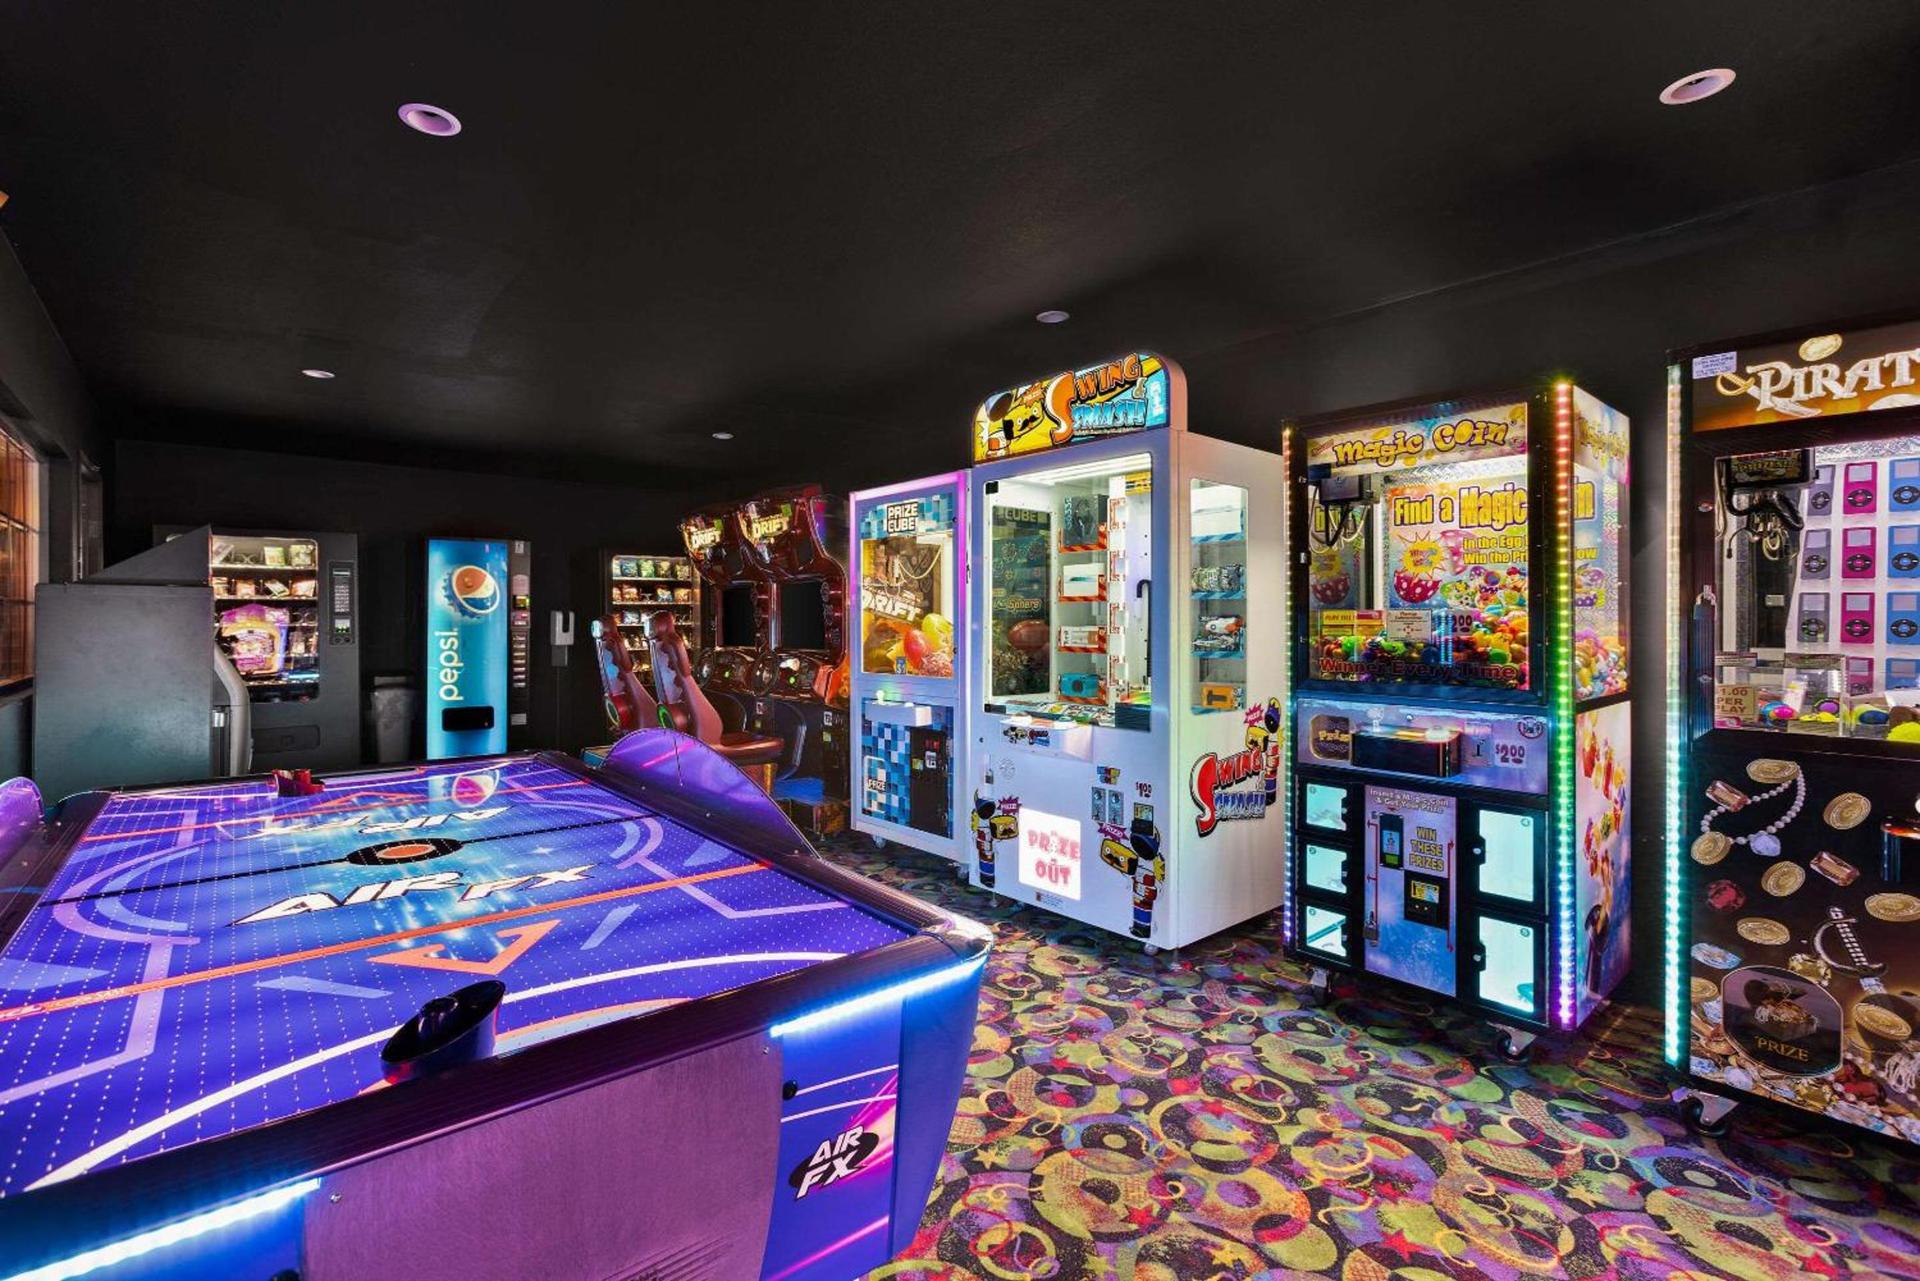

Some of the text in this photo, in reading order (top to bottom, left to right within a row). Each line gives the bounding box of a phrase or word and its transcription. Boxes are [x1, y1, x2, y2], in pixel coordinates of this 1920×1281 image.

[1044, 353, 1141, 444] SWING
[1072, 399, 1147, 429] SMASH
[887, 502, 918, 519] PRIZE
[1394, 495, 1434, 526] Find
[1438, 496, 1454, 523] a
[1459, 483, 1528, 531] Magic
[691, 530, 721, 549] DRIFT
[752, 517, 790, 539] DRIFT
[887, 518, 916, 534] CUBE
[1477, 537, 1498, 549] the
[1501, 535, 1523, 549] Egg
[1464, 551, 1487, 565] Win
[1489, 550, 1511, 564] the
[434, 630, 464, 701] pepsi
[1319, 658, 1519, 681] Winner Every Time
[1189, 746, 1264, 837] SWING
[1027, 829, 1080, 860] PRIZE
[1416, 826, 1437, 842] WIN
[1410, 839, 1443, 857] THESE
[1035, 858, 1071, 885] OUT
[1408, 853, 1445, 872] PRIZES
[225, 863, 601, 927] AIR FX
[1754, 1035, 1809, 1062] PRIZE
[808, 1125, 864, 1168] AIR
[795, 1149, 863, 1201] FX
